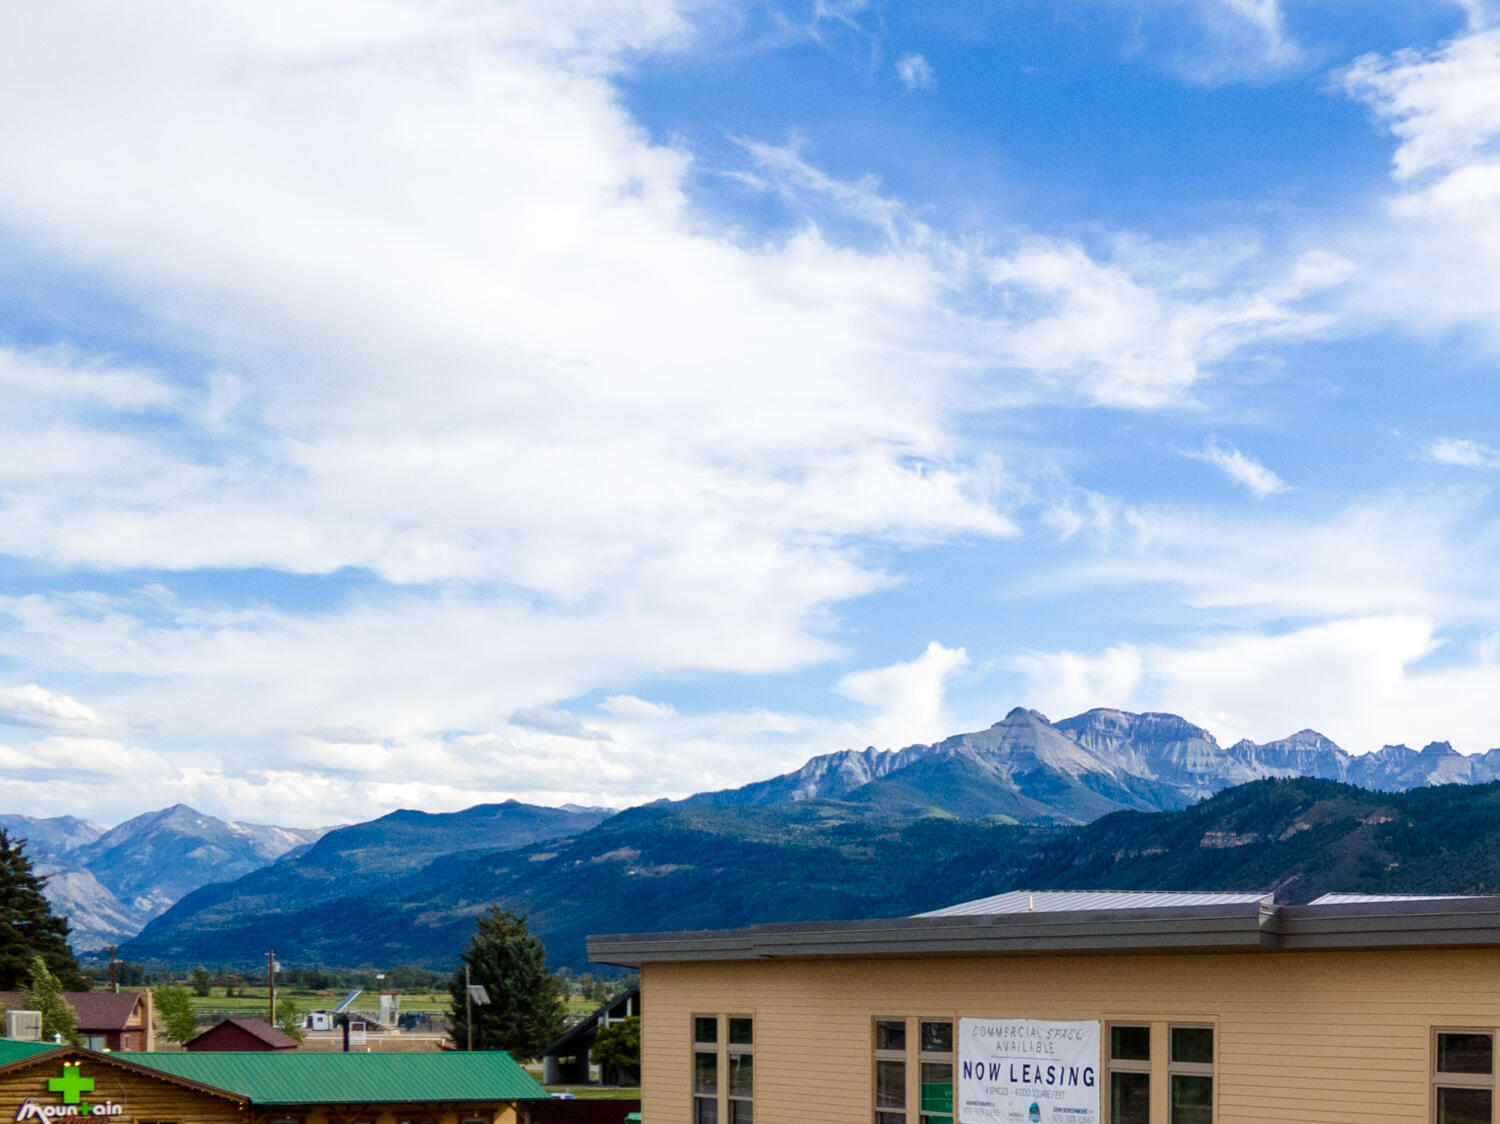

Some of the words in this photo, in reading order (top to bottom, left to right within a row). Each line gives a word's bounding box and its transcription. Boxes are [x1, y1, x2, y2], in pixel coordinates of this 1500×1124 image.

[972, 1025, 1042, 1039] COMMERCIAL
[1046, 1028, 1084, 1041] SPACE
[996, 1041, 1055, 1054] AVAILABLE
[963, 1061, 1001, 1082] NOW
[1010, 1063, 1096, 1087] LEASING
[1051, 1090, 1065, 1099] FEET
